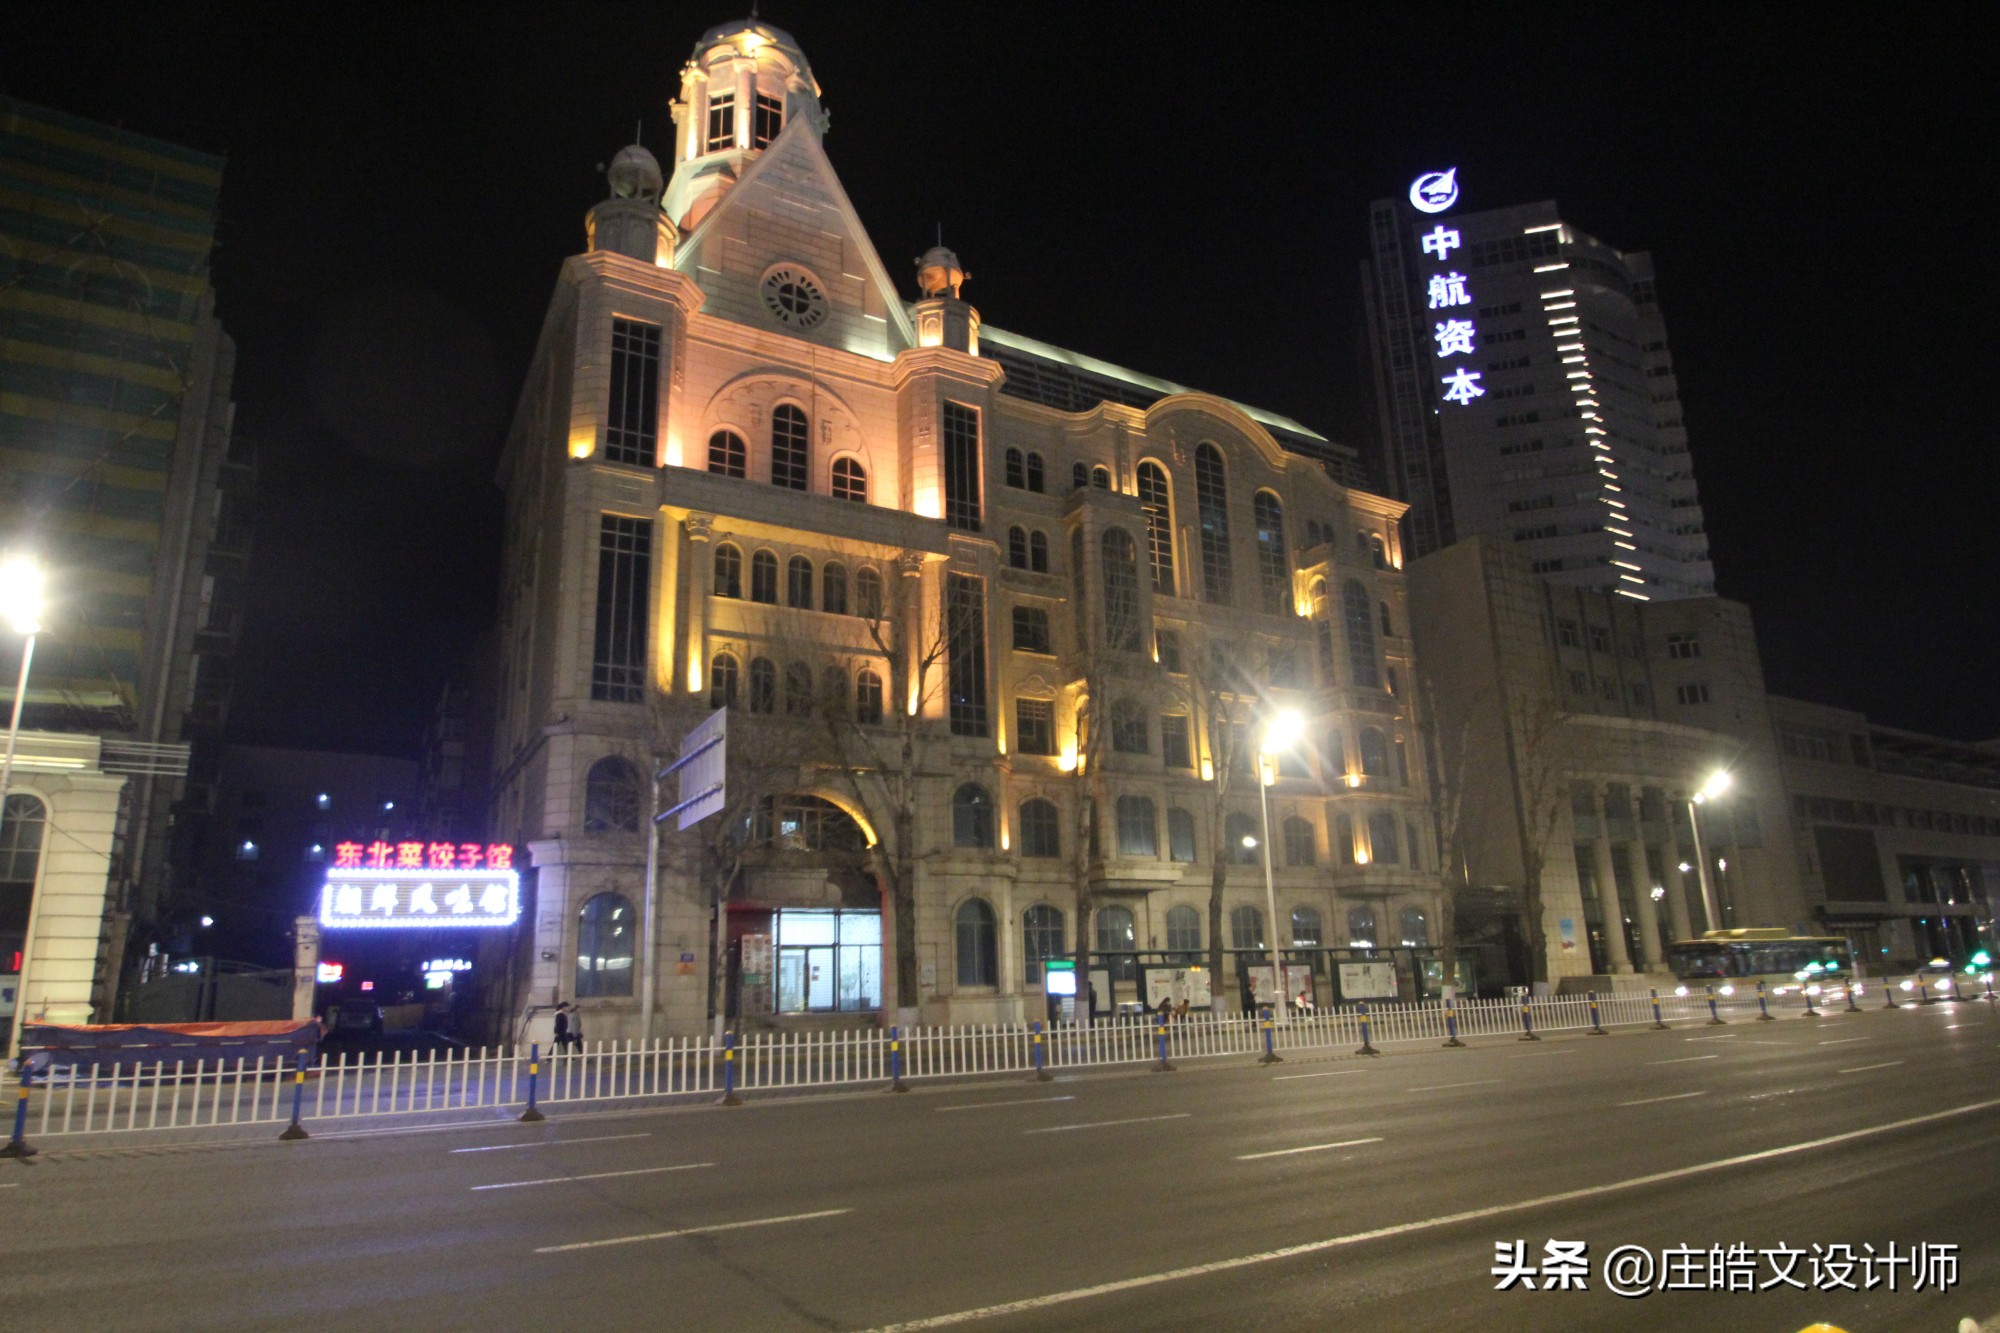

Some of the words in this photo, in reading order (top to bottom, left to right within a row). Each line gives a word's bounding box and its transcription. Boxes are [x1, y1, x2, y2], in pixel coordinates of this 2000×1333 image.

[1421, 225, 1486, 406] 中航资本
[334, 840, 514, 870] 东北菜饺子馆
